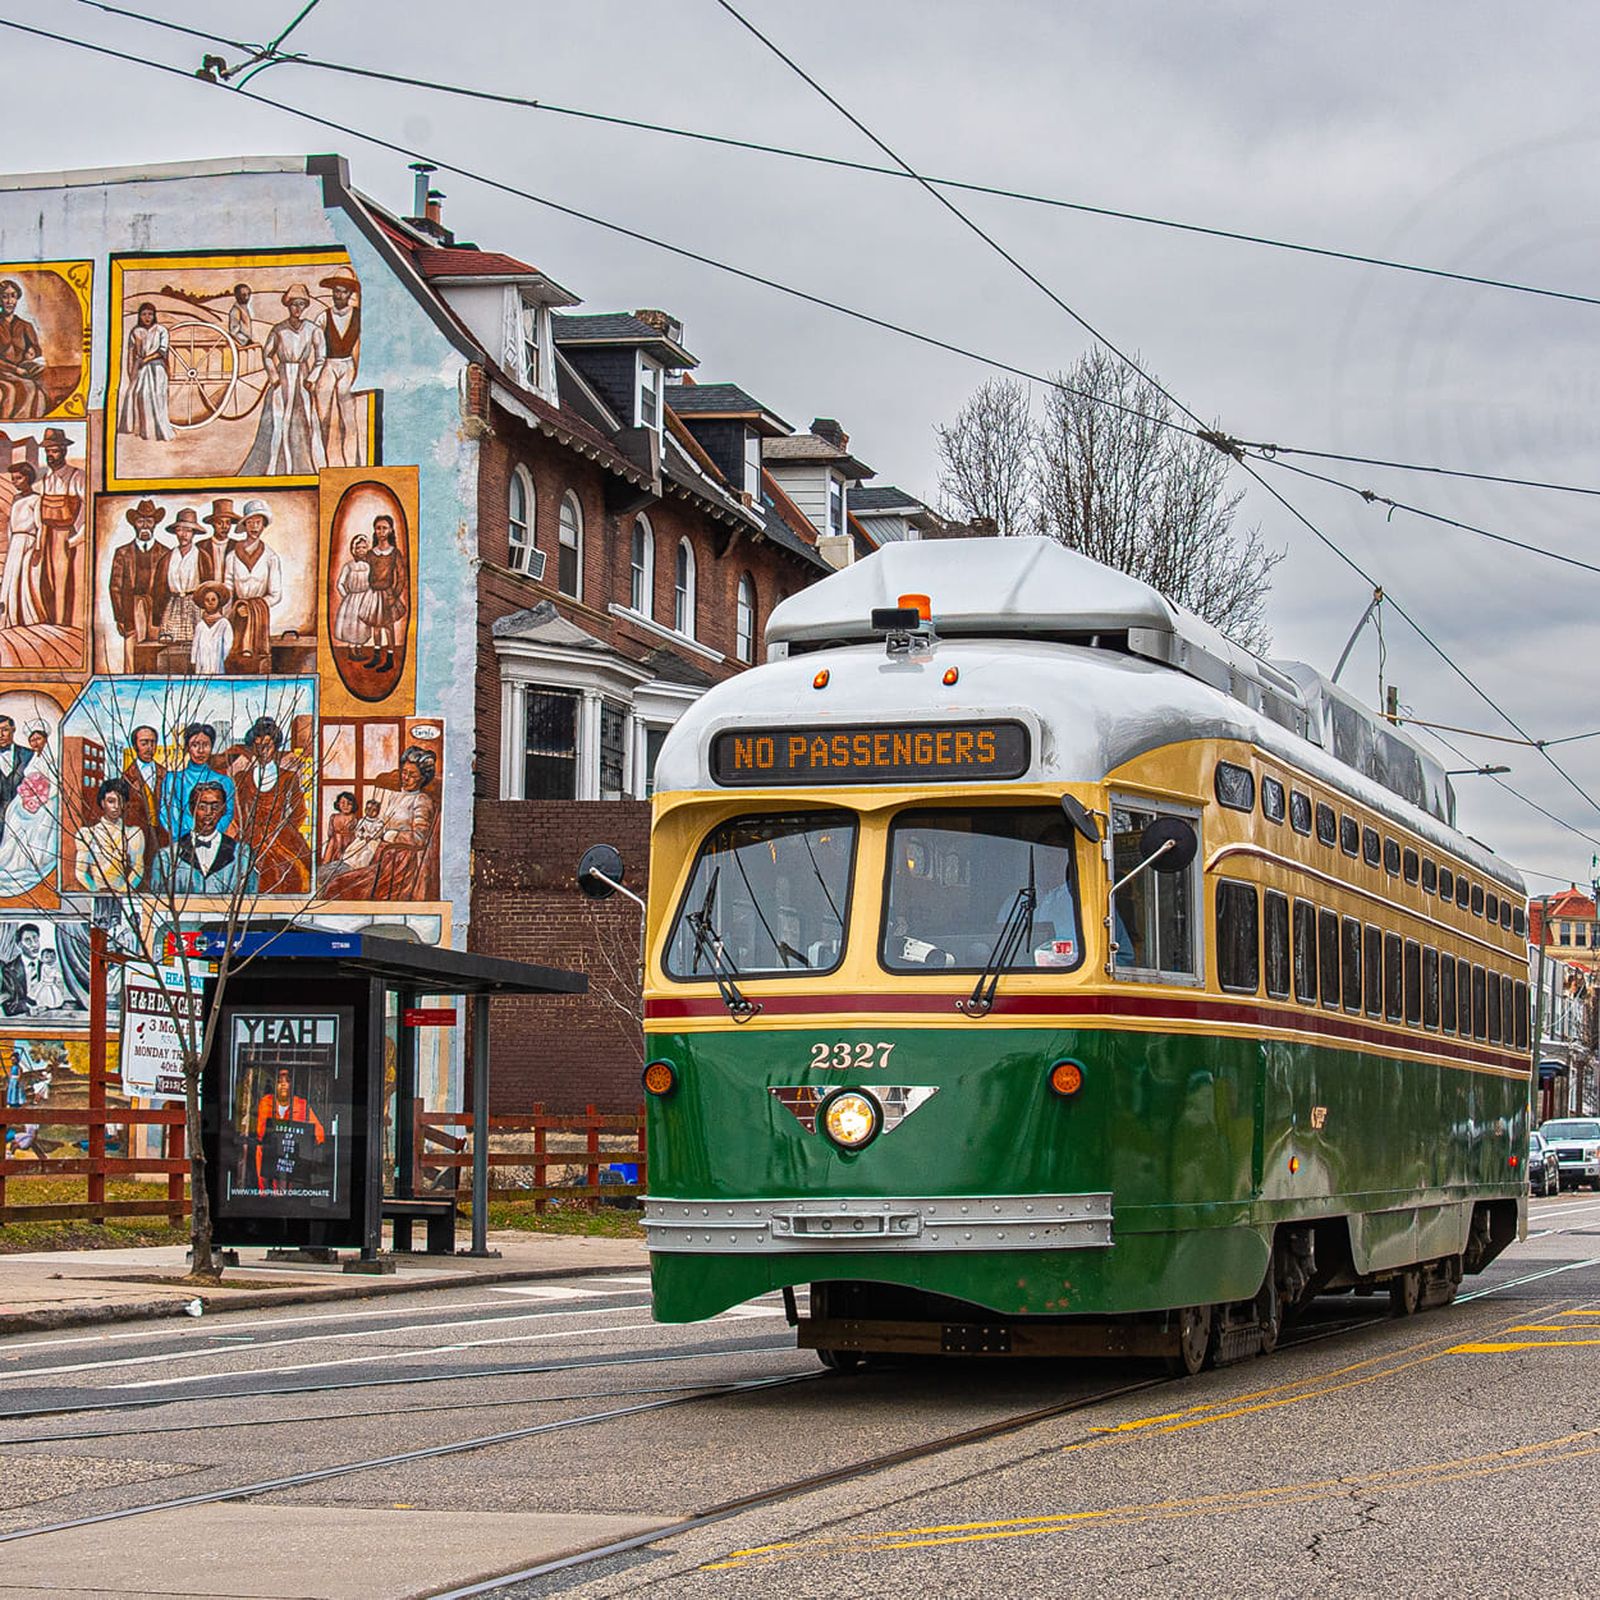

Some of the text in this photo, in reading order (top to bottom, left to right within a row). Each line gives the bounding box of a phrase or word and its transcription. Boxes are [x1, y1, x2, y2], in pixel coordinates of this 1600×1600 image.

[735, 731, 997, 769] NO PASSENGERS
[149, 1019, 157, 1031] 3
[242, 1017, 317, 1044] YEAH
[134, 1045, 170, 1059] MONDAY
[810, 1042, 896, 1071] 2327
[275, 1125, 304, 1134] LOOKING
